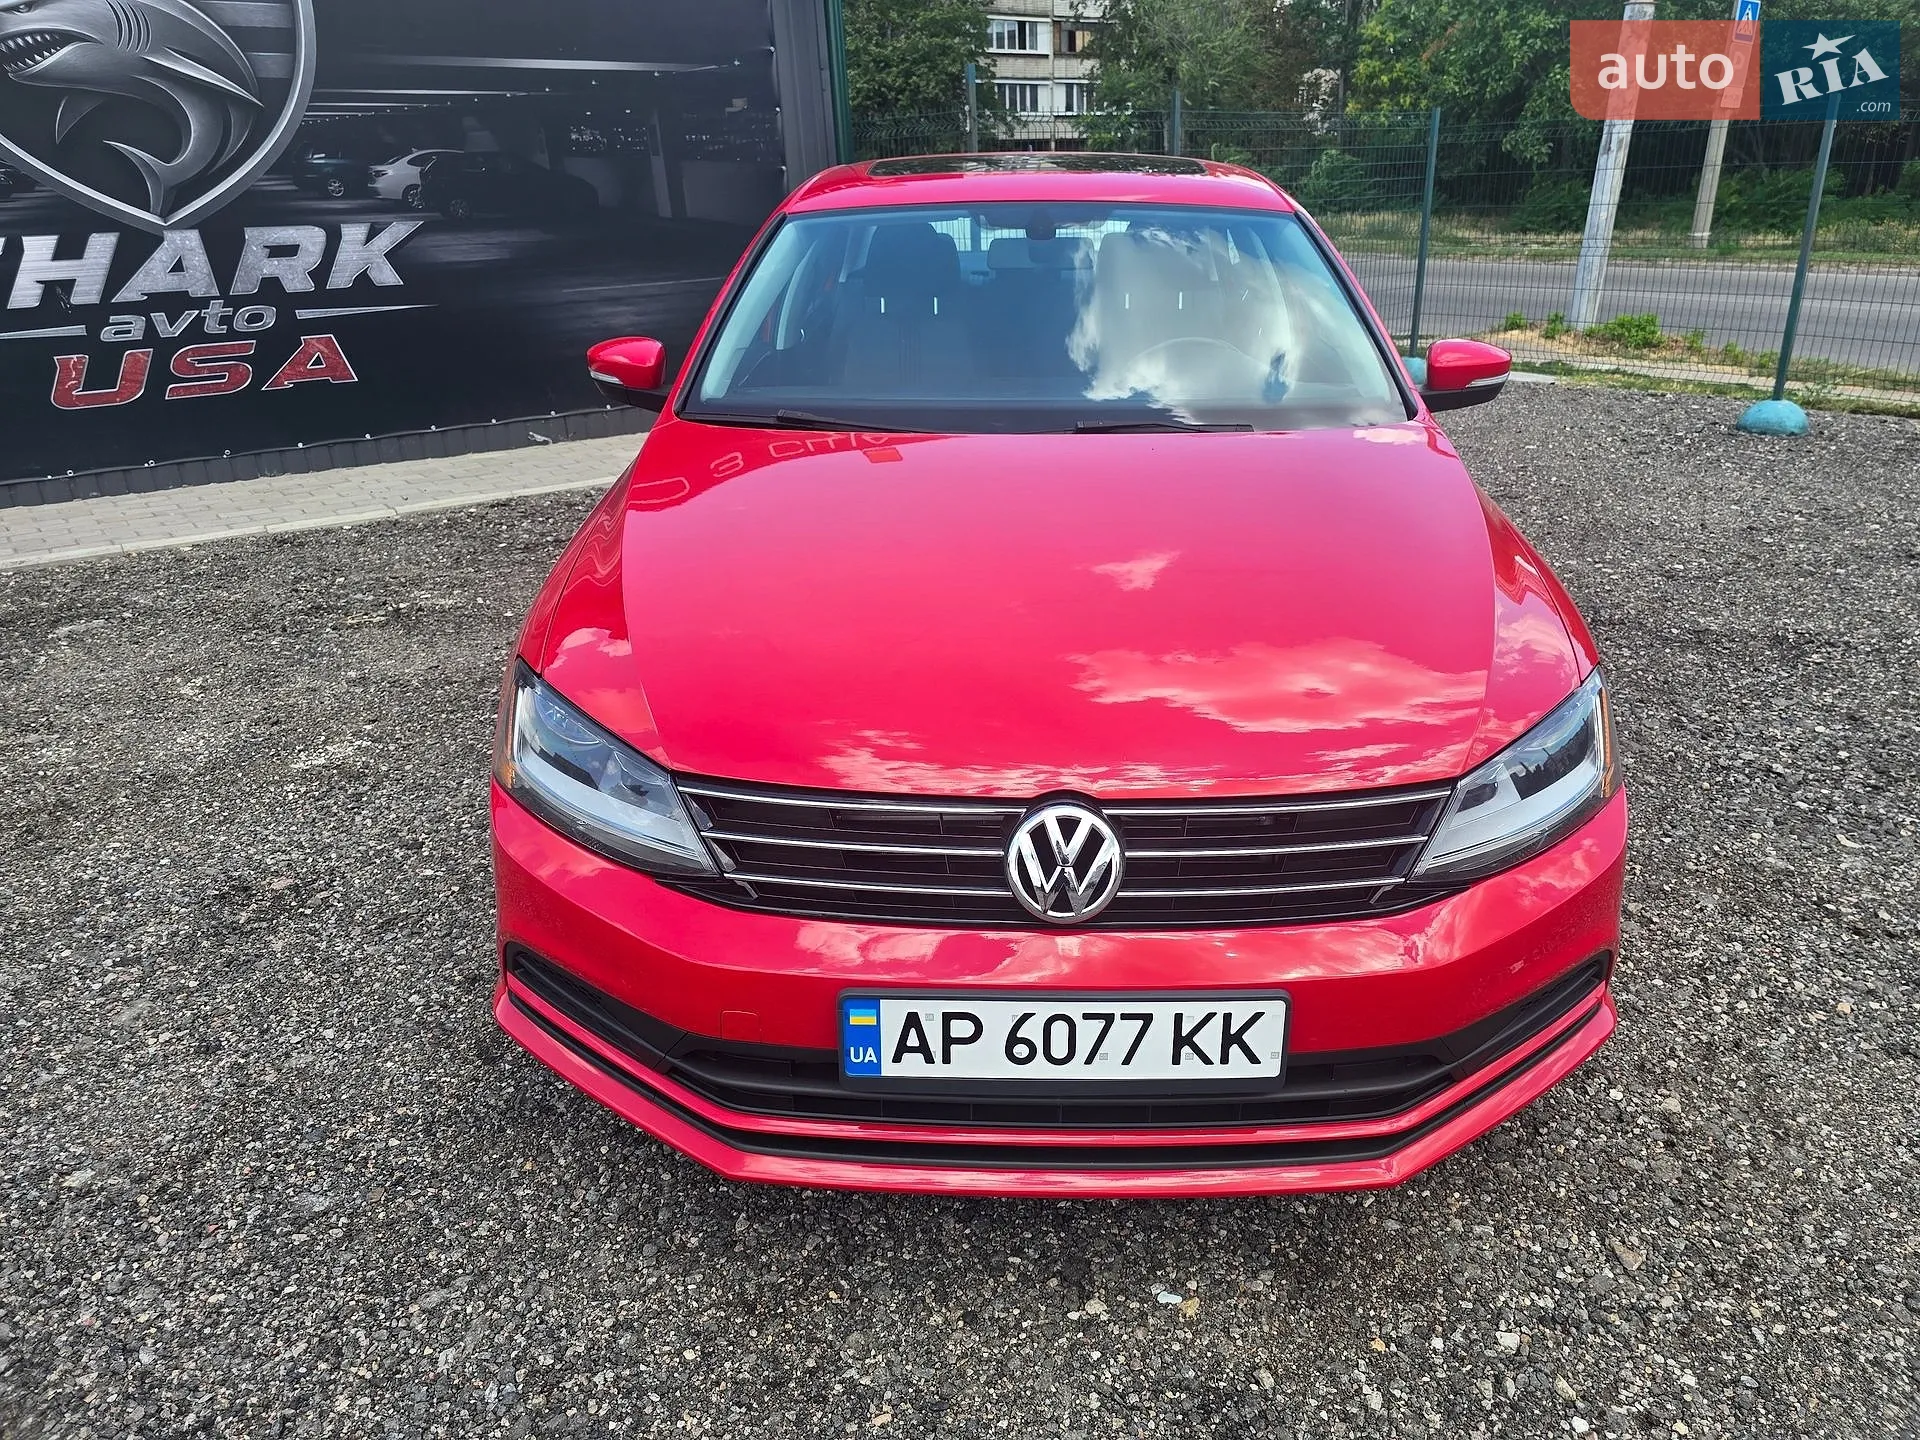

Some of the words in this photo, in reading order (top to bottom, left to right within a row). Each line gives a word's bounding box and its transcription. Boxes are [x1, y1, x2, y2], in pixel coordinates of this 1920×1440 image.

[0, 220, 424, 309] HARK
[100, 300, 277, 342] avto
[51, 333, 358, 410] USA
[850, 1046, 878, 1064] UA
[891, 1011, 984, 1065] AP
[1004, 1012, 1154, 1066] 6077
[1171, 1011, 1266, 1066] KK
